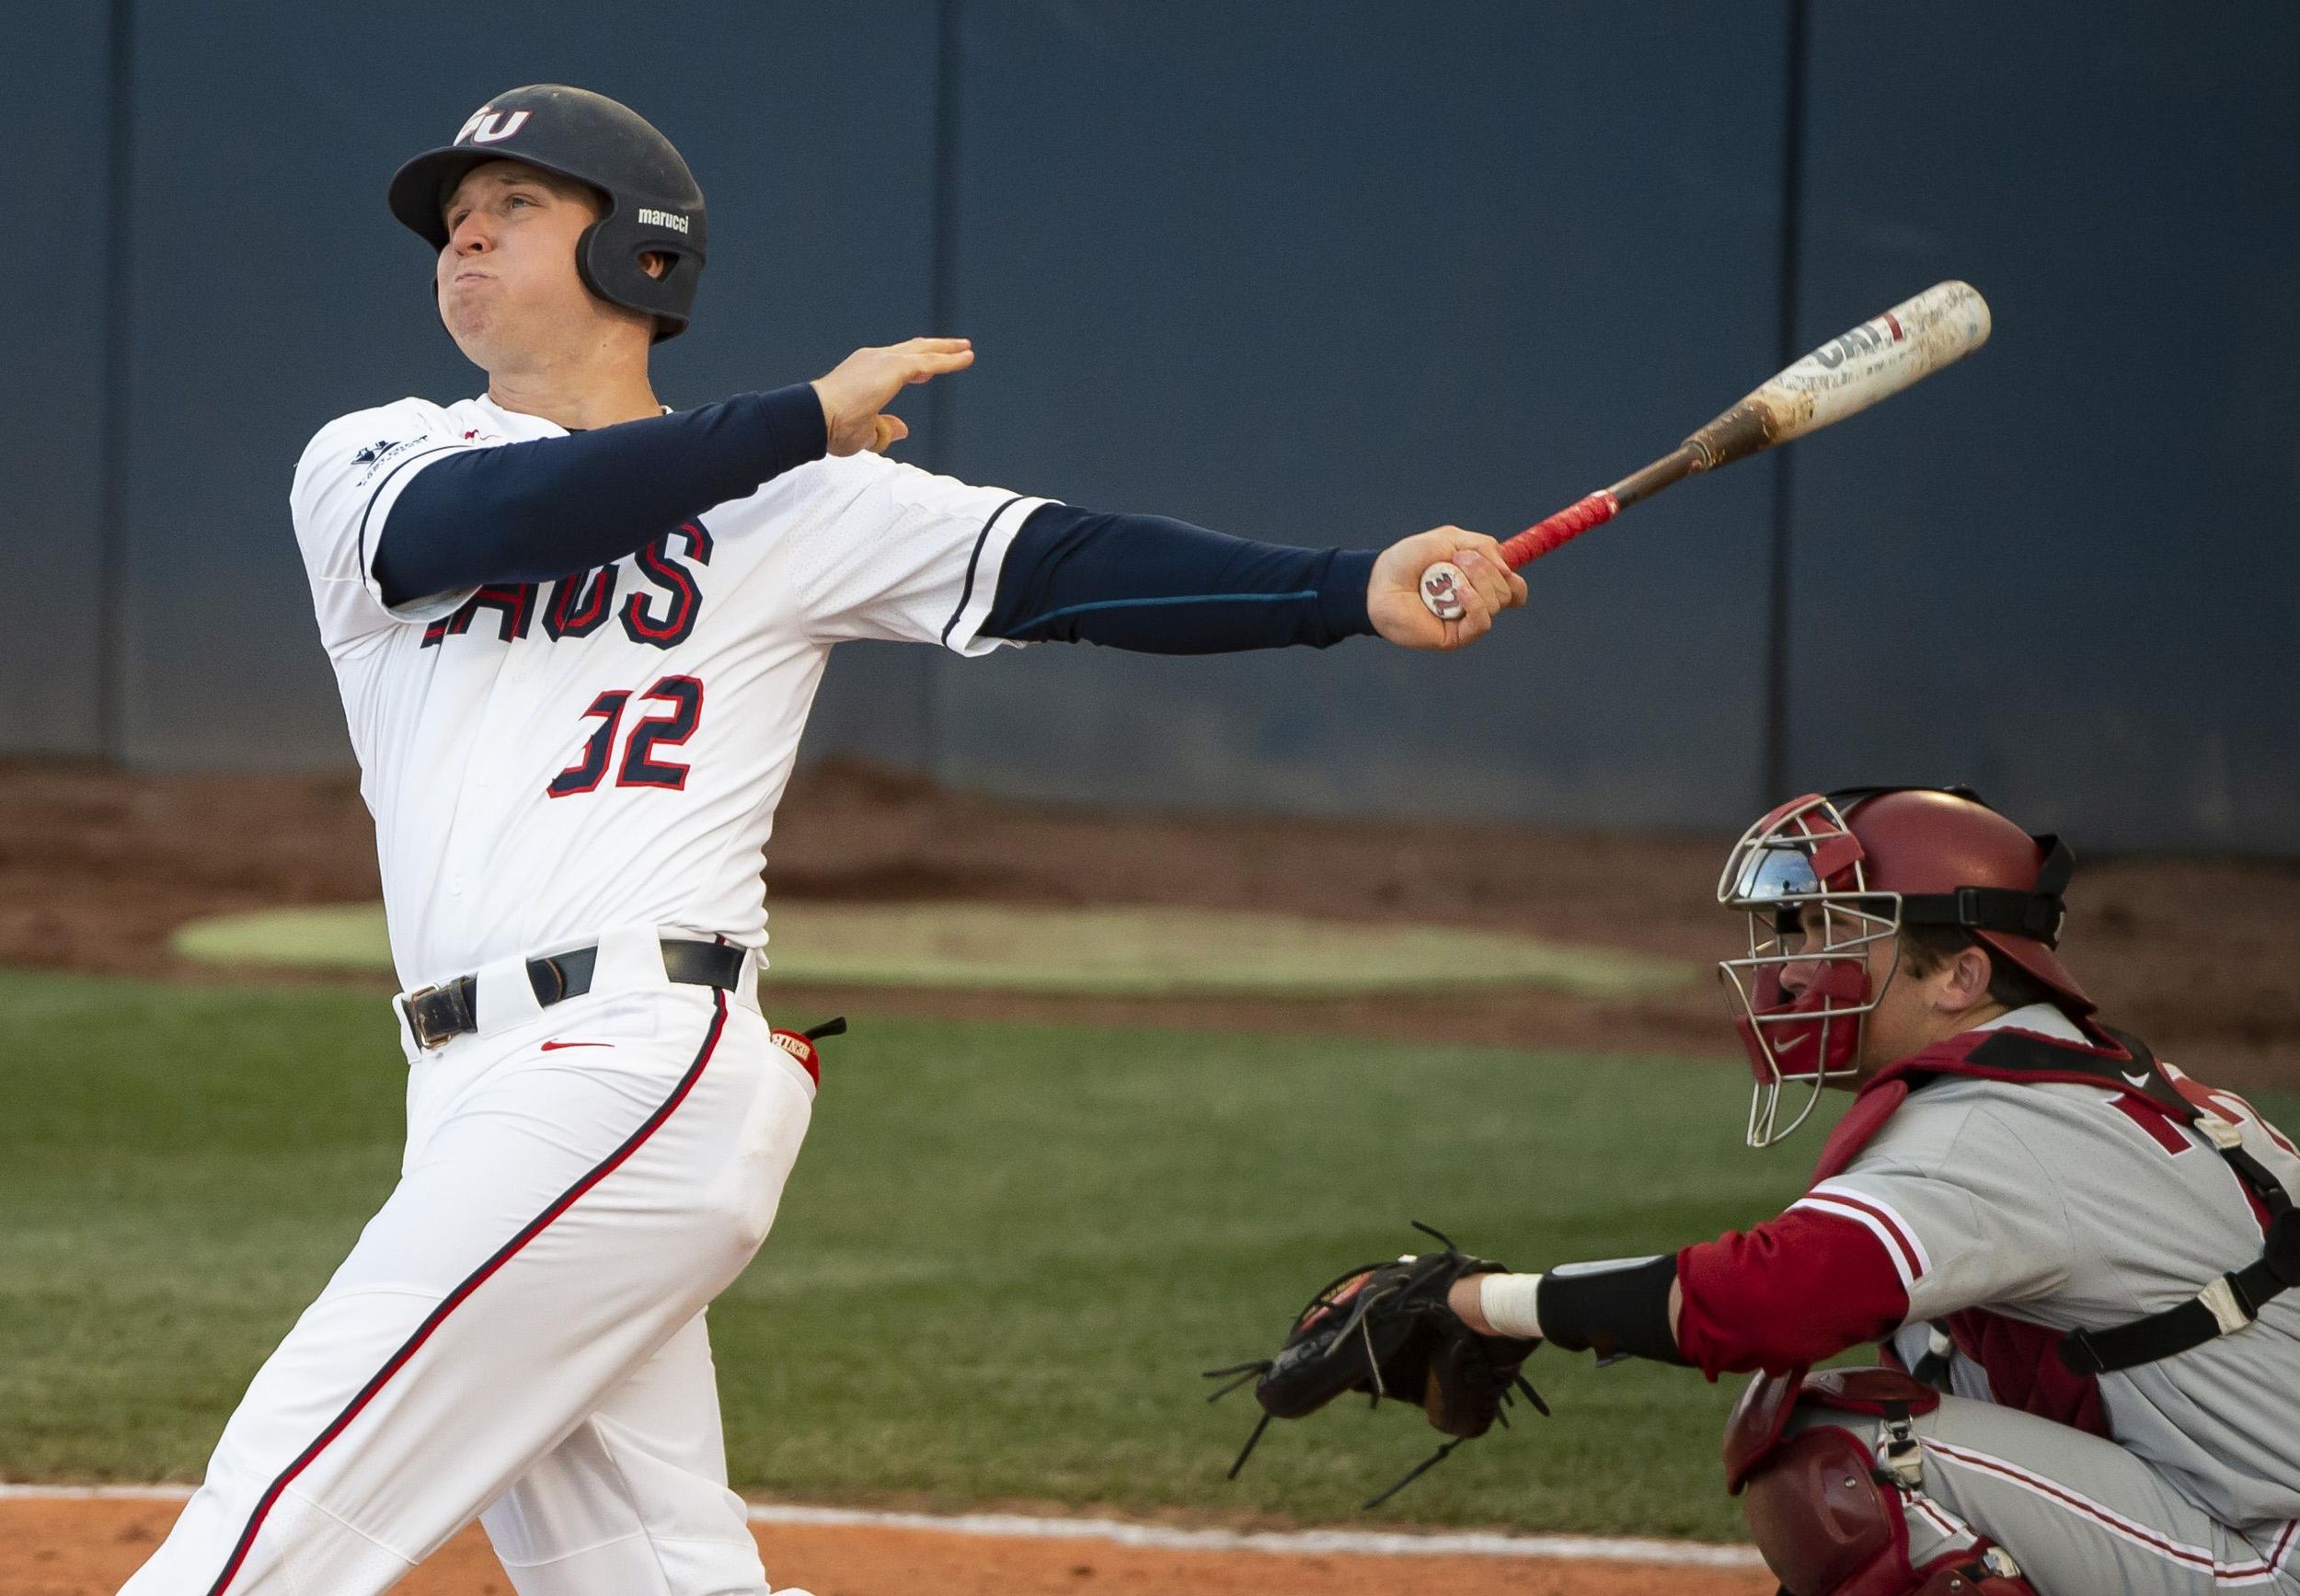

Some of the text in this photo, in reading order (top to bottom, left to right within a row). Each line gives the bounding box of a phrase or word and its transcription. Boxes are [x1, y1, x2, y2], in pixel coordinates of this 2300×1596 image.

[638, 208, 689, 234] marucci
[1425, 572, 1460, 615] 32
[546, 674, 703, 798] 32
